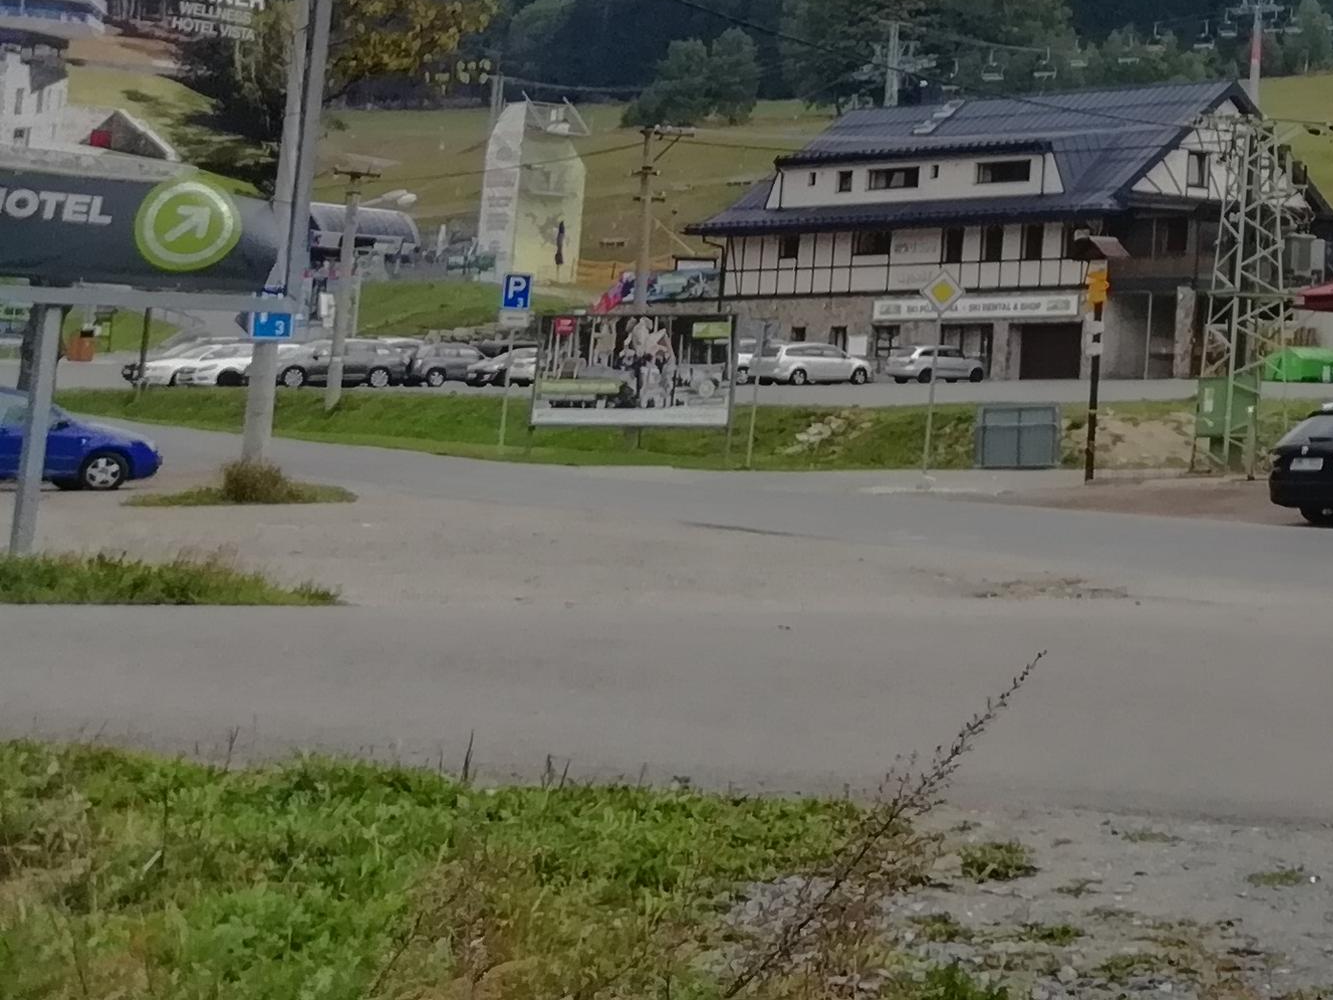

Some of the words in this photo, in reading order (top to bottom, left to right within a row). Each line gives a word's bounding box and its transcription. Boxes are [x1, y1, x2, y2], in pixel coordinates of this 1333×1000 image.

[179, 1, 252, 24] WELLNESS
[172, 16, 218, 35] HOTEL
[219, 23, 256, 41] VISTA
[508, 276, 527, 299] P
[274, 320, 285, 335] 3
